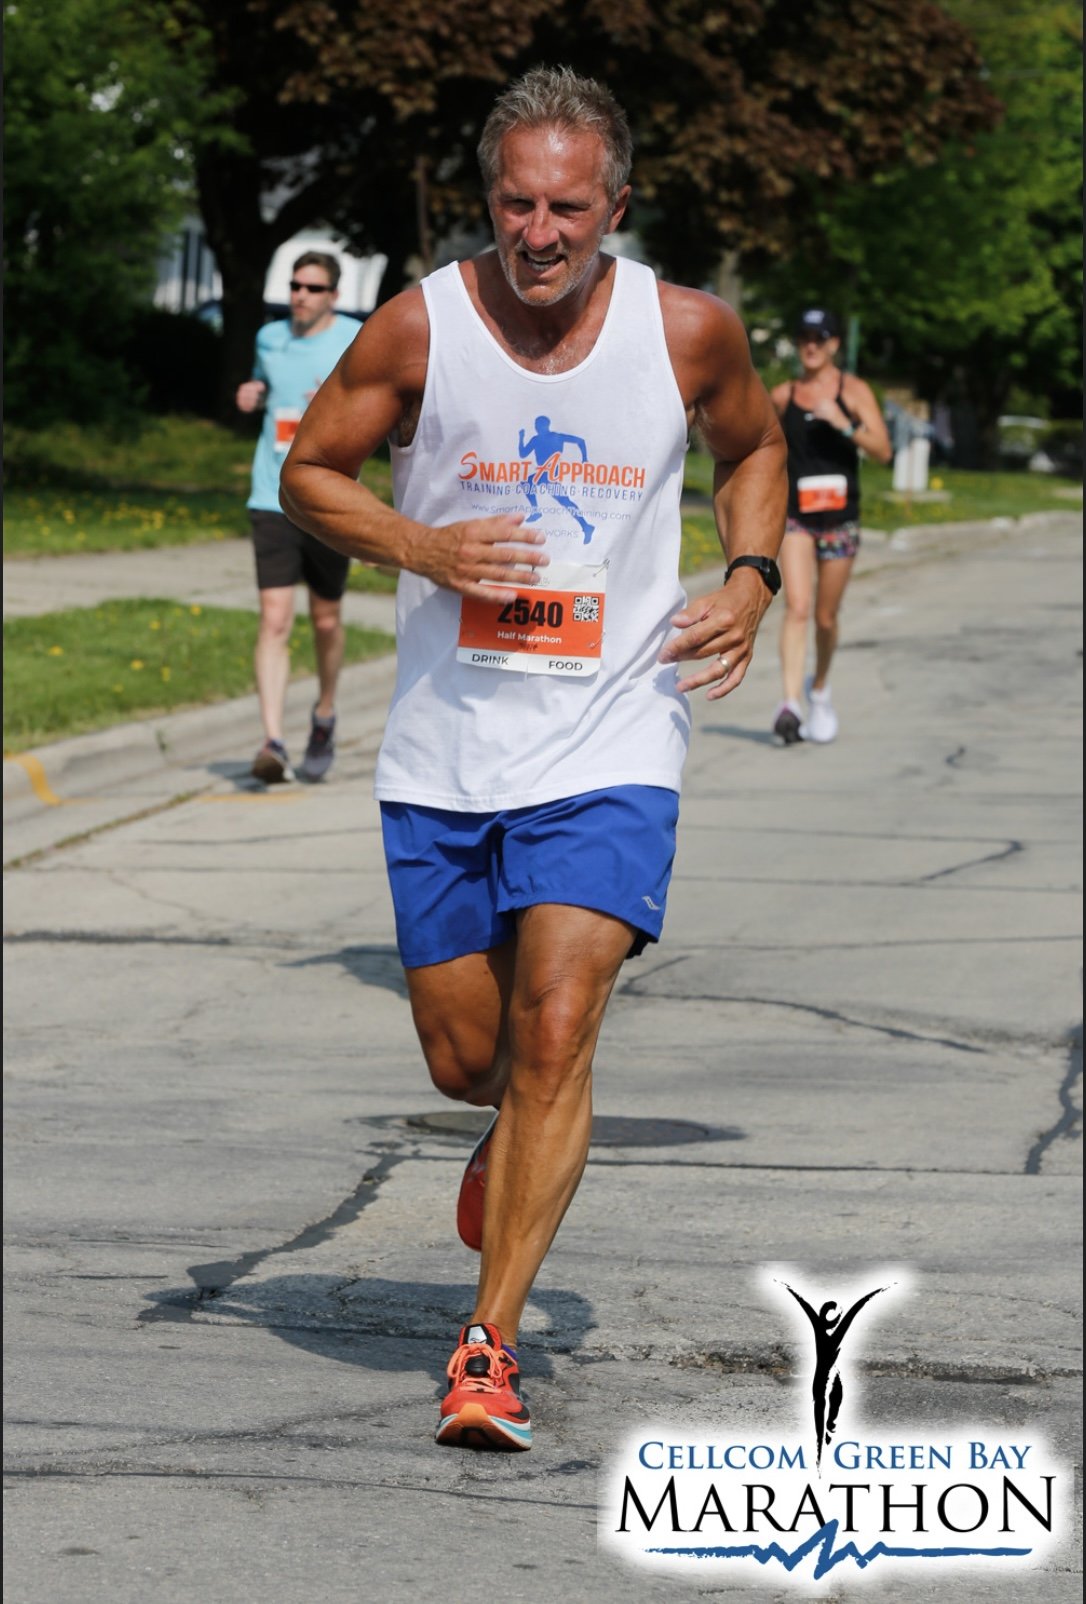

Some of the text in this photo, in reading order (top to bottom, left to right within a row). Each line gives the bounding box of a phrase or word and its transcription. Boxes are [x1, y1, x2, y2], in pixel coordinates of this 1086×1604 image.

[460, 480, 644, 502] TRAINING COACHING RECOVERY
[497, 597, 564, 628] 2540
[497, 630, 562, 644] Half Marathon
[472, 653, 583, 671] DRINK FOOD
